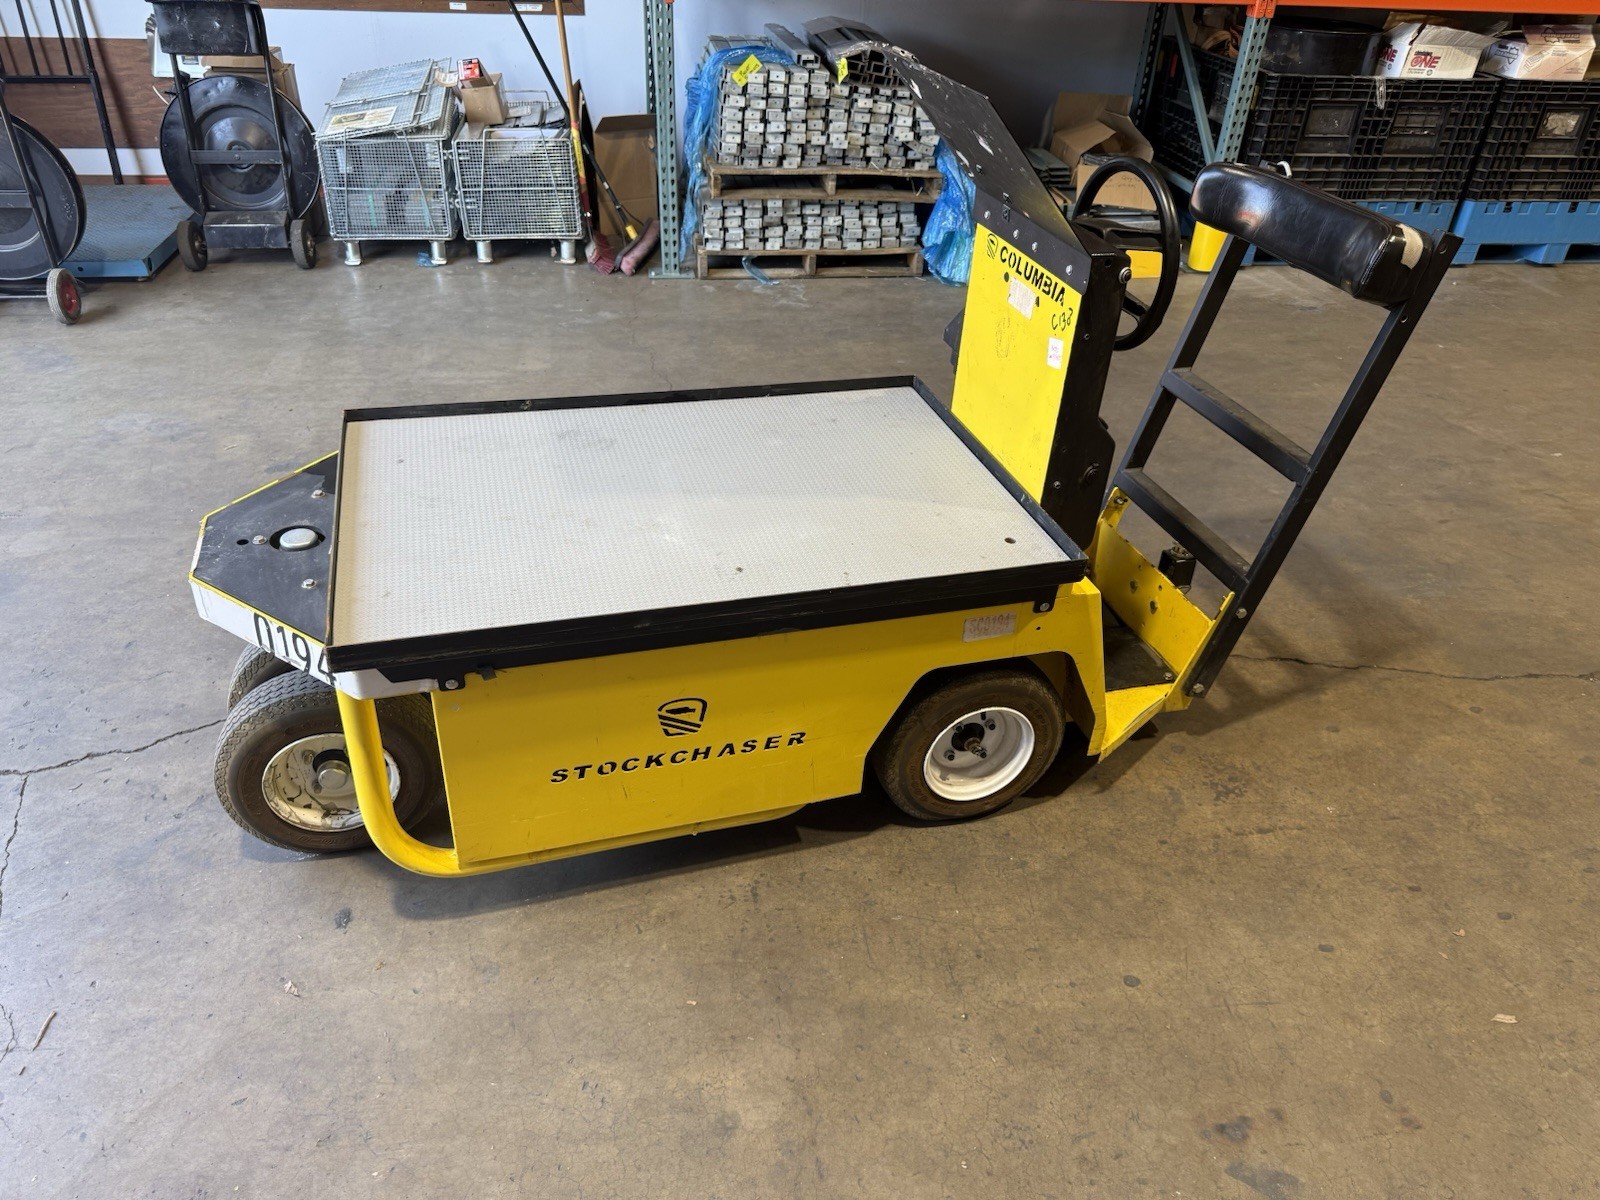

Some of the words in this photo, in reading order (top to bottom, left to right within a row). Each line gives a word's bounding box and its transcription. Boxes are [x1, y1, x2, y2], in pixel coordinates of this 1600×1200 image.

[1410, 55, 1441, 68] ONE
[1000, 246, 1066, 307] COLUMBIA
[550, 732, 808, 784] STOCKCHASER
